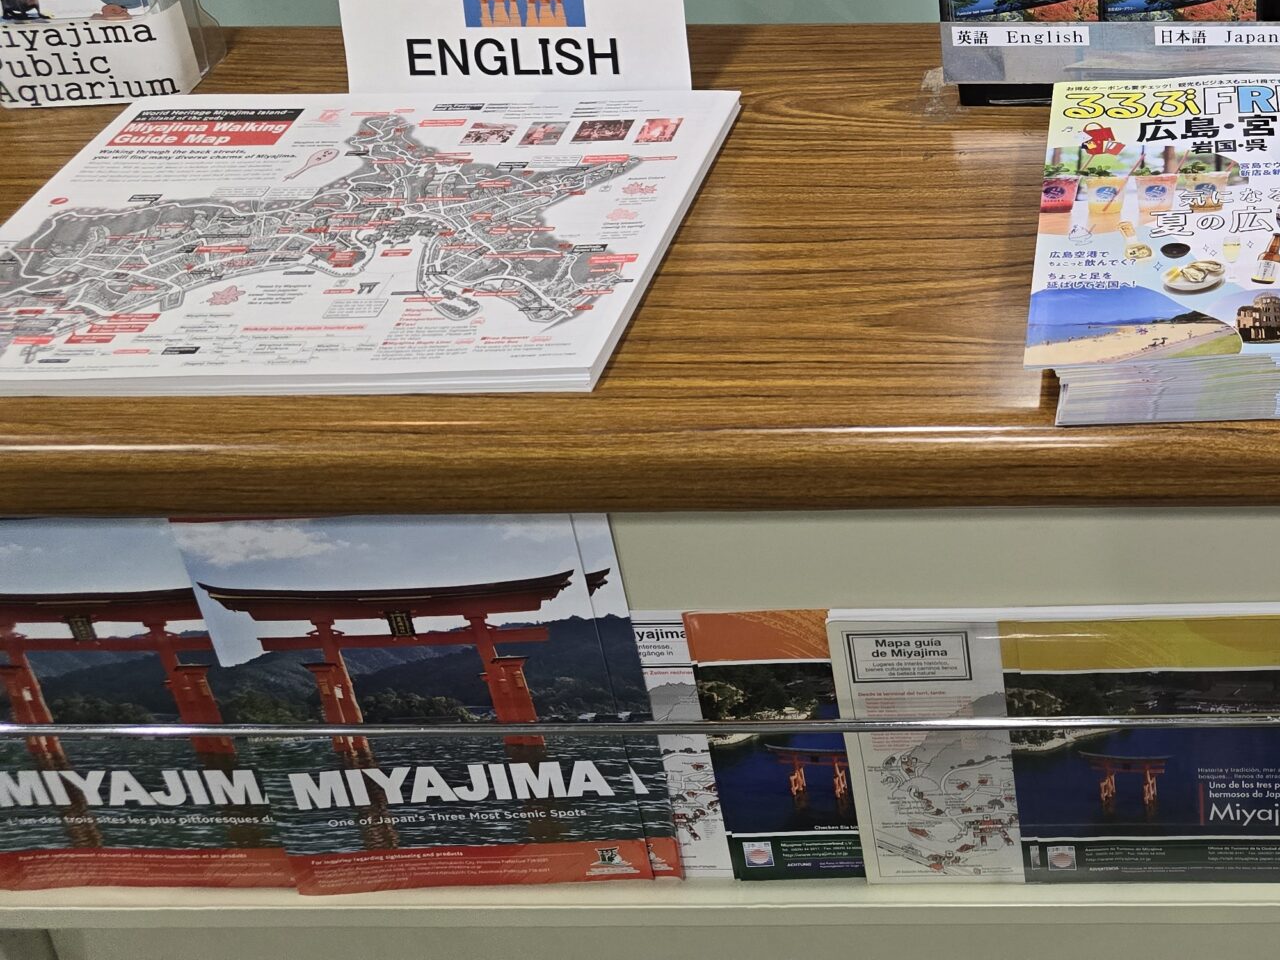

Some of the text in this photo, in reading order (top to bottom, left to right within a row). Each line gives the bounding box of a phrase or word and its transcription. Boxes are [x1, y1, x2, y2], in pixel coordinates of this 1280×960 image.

[0, 21, 157, 52] iyajima
[957, 30, 1084, 46] 英語 English
[1160, 30, 1207, 45] 日本語
[407, 38, 621, 77] ENGLISH
[0, 76, 180, 107] Aquarium
[1063, 88, 1200, 119] るるぶ
[124, 122, 288, 135] Miyajima Walking
[113, 134, 232, 146] Guide Map
[1191, 138, 1268, 155] 岩国・呉
[1049, 250, 1110, 260] 広島空港で
[1047, 271, 1112, 281] ちょっと足を
[875, 638, 942, 648] Mapa guía
[871, 648, 948, 659] de Miyajima
[0, 770, 270, 807] MIYAJIM
[288, 760, 615, 810] MIYAJIMA
[1209, 781, 1227, 789] Uno
[1228, 781, 1240, 789] de
[1242, 781, 1254, 789] los
[1256, 781, 1272, 789] tres
[1209, 790, 1250, 798] hermosos
[1252, 790, 1263, 798] de
[64, 815, 259, 826] trois sites les plus pittoresques
[328, 808, 588, 828] One of Japan's Three Most Scenic Spots
